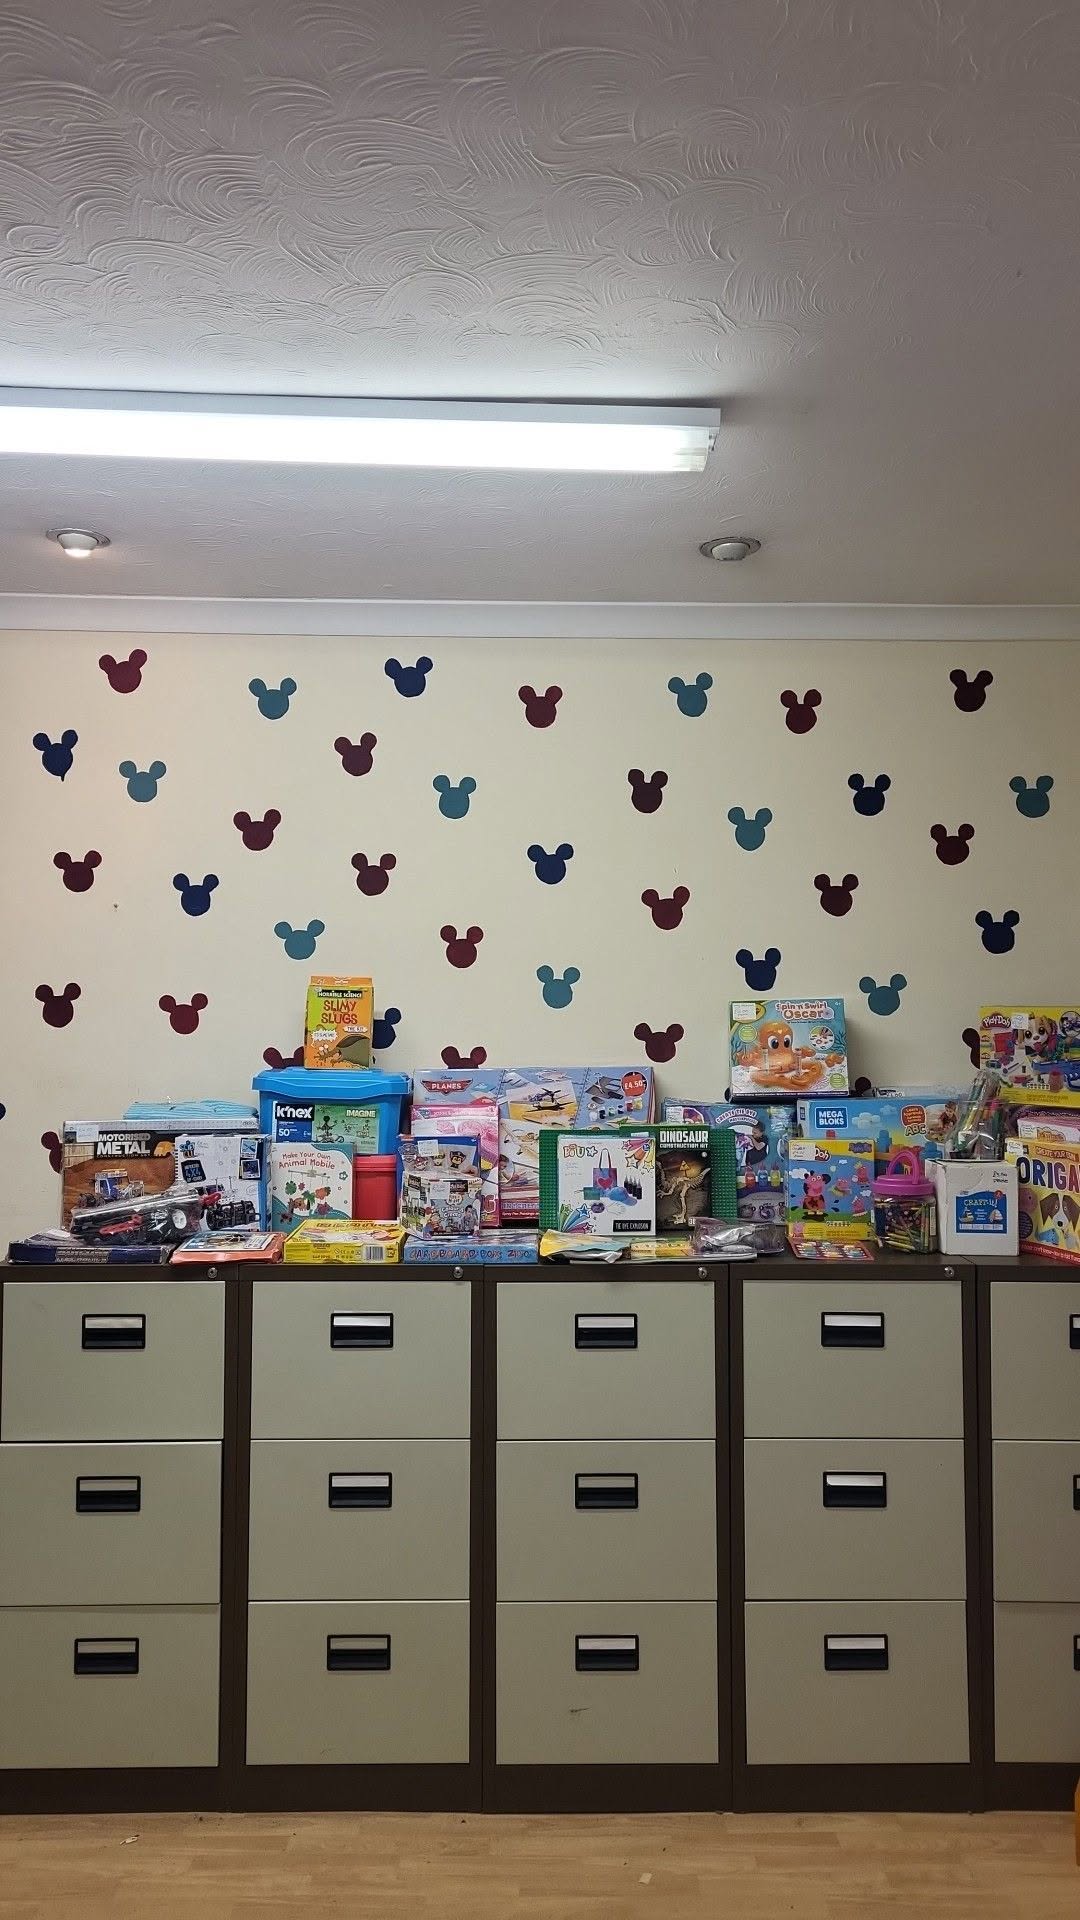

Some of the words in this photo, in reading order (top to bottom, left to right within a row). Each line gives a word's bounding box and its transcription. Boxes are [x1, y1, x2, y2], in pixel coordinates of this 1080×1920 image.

[323, 999, 357, 1012] SLIMY
[776, 1002, 796, 1010] Spin
[804, 1001, 827, 1009] Swirl
[321, 1012, 358, 1025] SLUGS
[783, 1009, 824, 1019] Oscar
[624, 1081, 644, 1090] £4.50
[346, 1109, 376, 1118] IMAGINE
[818, 1110, 844, 1118] MEGA
[818, 1118, 845, 1126] BLOKS
[278, 1128, 290, 1137] 50
[905, 1124, 927, 1137] ABC
[99, 1133, 151, 1142] MOTORISED
[659, 1130, 709, 1143] DINOSAUR
[97, 1142, 151, 1155] METAL
[300, 1151, 315, 1159] Your
[317, 1152, 331, 1160] Own
[278, 1158, 308, 1169] Animal
[309, 1160, 336, 1170] Mobile
[1016, 1156, 1080, 1194] ORIGA
